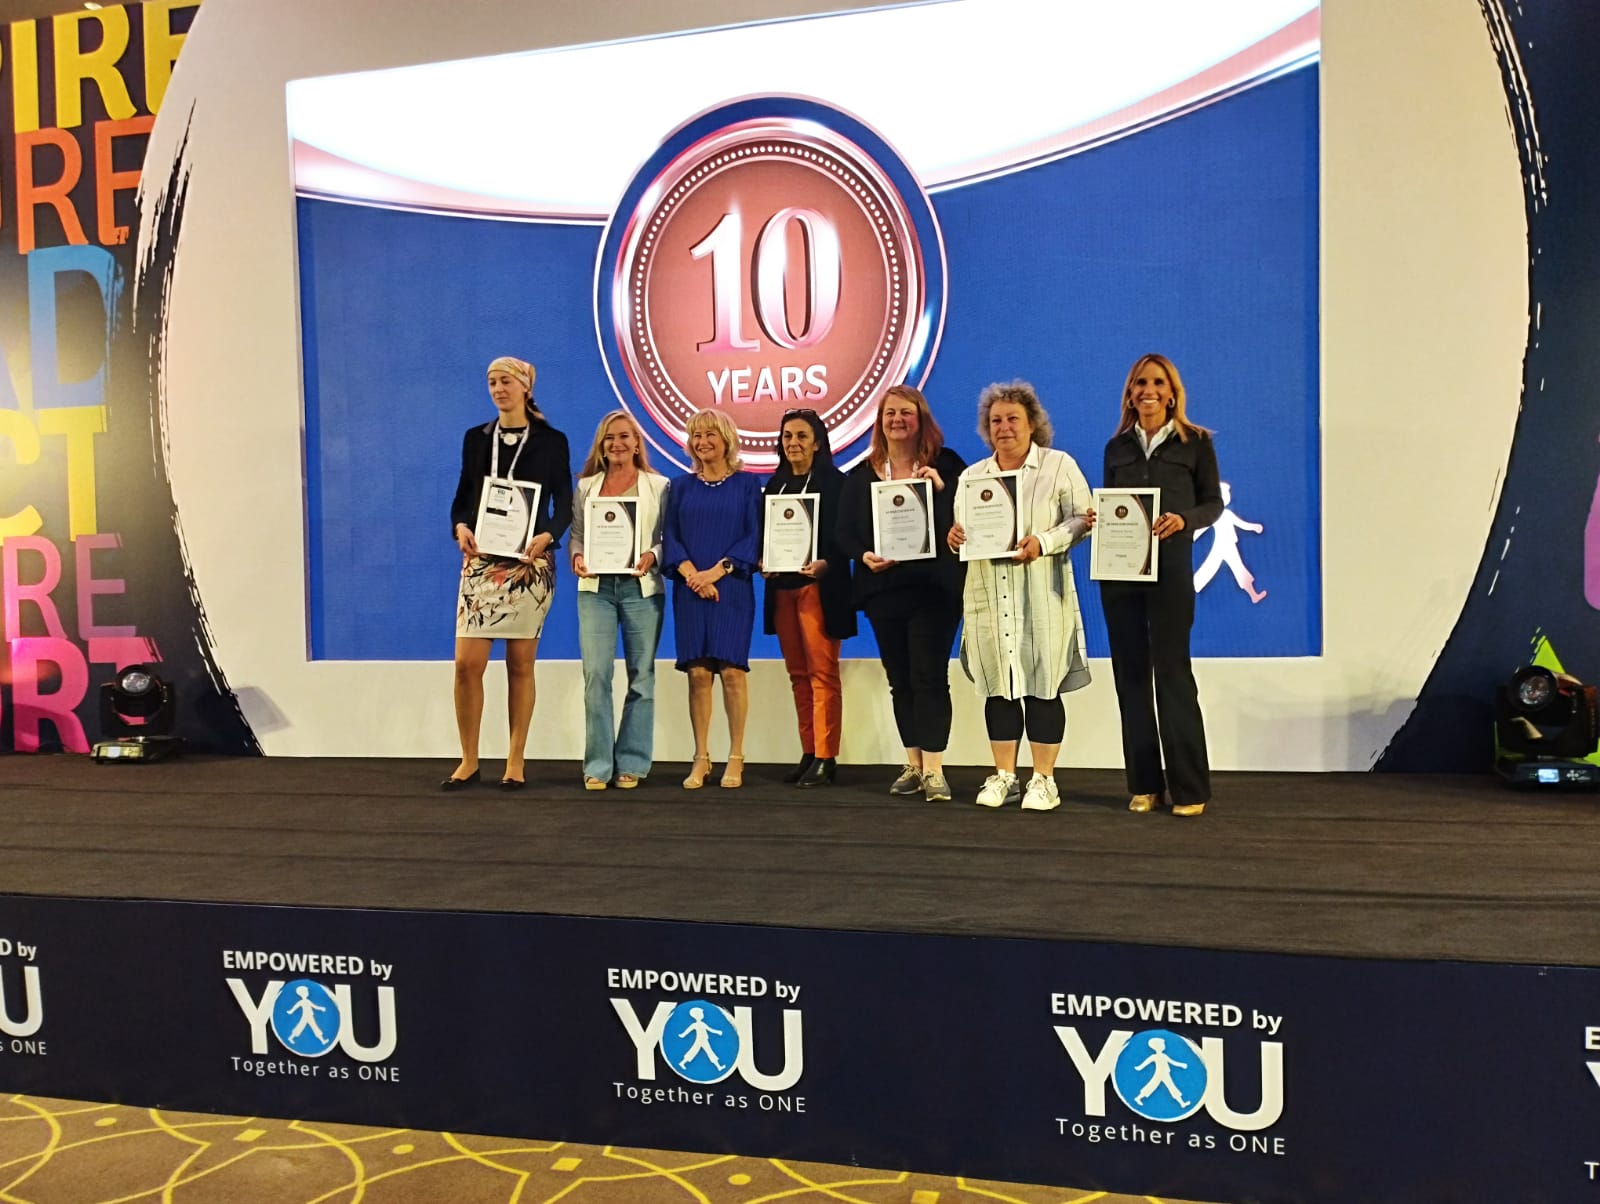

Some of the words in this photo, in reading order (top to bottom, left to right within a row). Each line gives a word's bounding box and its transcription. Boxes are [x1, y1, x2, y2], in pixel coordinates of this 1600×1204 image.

[0, 0, 202, 133] IRE
[0, 115, 156, 255] RE
[689, 205, 842, 351] 10
[706, 364, 828, 404] YEARS
[3, 533, 136, 642] RE
[0, 637, 163, 753] RT
[17, 941, 37, 961] by
[222, 950, 364, 976] EMPOWERED
[370, 960, 393, 981] by
[607, 967, 767, 997] EMPOWERED
[775, 981, 800, 1003] by
[225, 978, 398, 1063] YOU
[1051, 993, 1243, 1027] EMPOWERED
[1252, 1010, 1283, 1036] by
[11, 1039, 47, 1055] ONE
[609, 998, 803, 1092] YOU
[231, 1056, 319, 1077] Together
[328, 1066, 349, 1079] as
[358, 1065, 400, 1082] ONE
[1053, 1025, 1284, 1131] YOU
[613, 1082, 714, 1105] Together
[724, 1095, 748, 1109] as
[759, 1095, 806, 1113] ONE
[1056, 1118, 1175, 1143] Together
[1188, 1133, 1216, 1149] as
[1230, 1134, 1286, 1155] ONE
